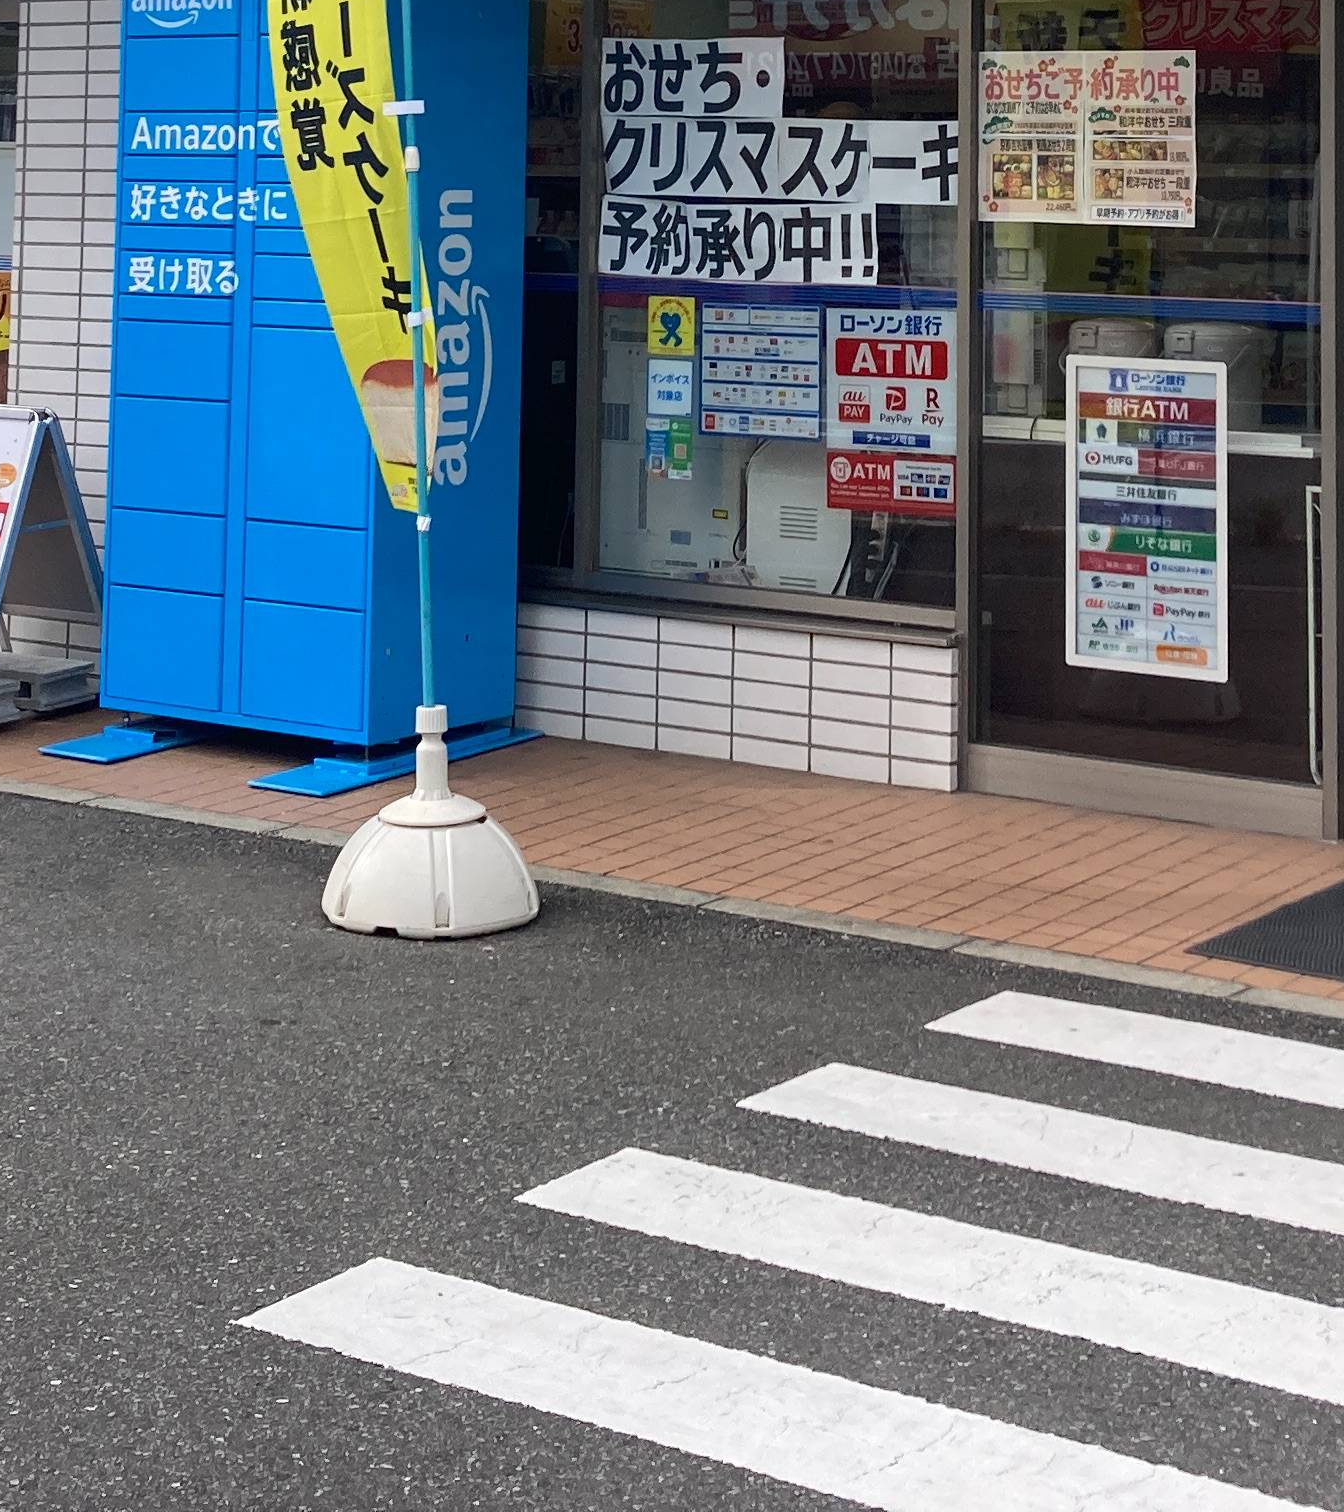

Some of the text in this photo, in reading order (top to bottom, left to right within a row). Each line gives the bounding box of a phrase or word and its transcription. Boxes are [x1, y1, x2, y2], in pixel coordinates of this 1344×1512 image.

[985, 68, 1180, 101] おせちご予約承り中
[605, 119, 959, 201] クリスマスケーキ
[130, 185, 288, 222] 好きなときに
[602, 201, 875, 283] 予約承り中!!
[128, 256, 240, 295] 受け取る
[840, 314, 944, 337] ローソン銀行
[433, 189, 474, 487] amazon
[851, 342, 934, 377] ATM
[650, 374, 691, 386] インボイス
[1131, 373, 1186, 386] ローソン銀行
[842, 390, 866, 404] au
[842, 405, 866, 419] PAY
[1105, 396, 1189, 421] 銀行ATM
[879, 413, 913, 426] PayPay
[922, 414, 944, 428] Pay
[1102, 454, 1133, 466] MUFG
[853, 463, 891, 481] ATM
[1115, 486, 1177, 501] 三井住友銀行
[1135, 535, 1192, 553] りそな銀行
[1165, 606, 1196, 619] PayPay
